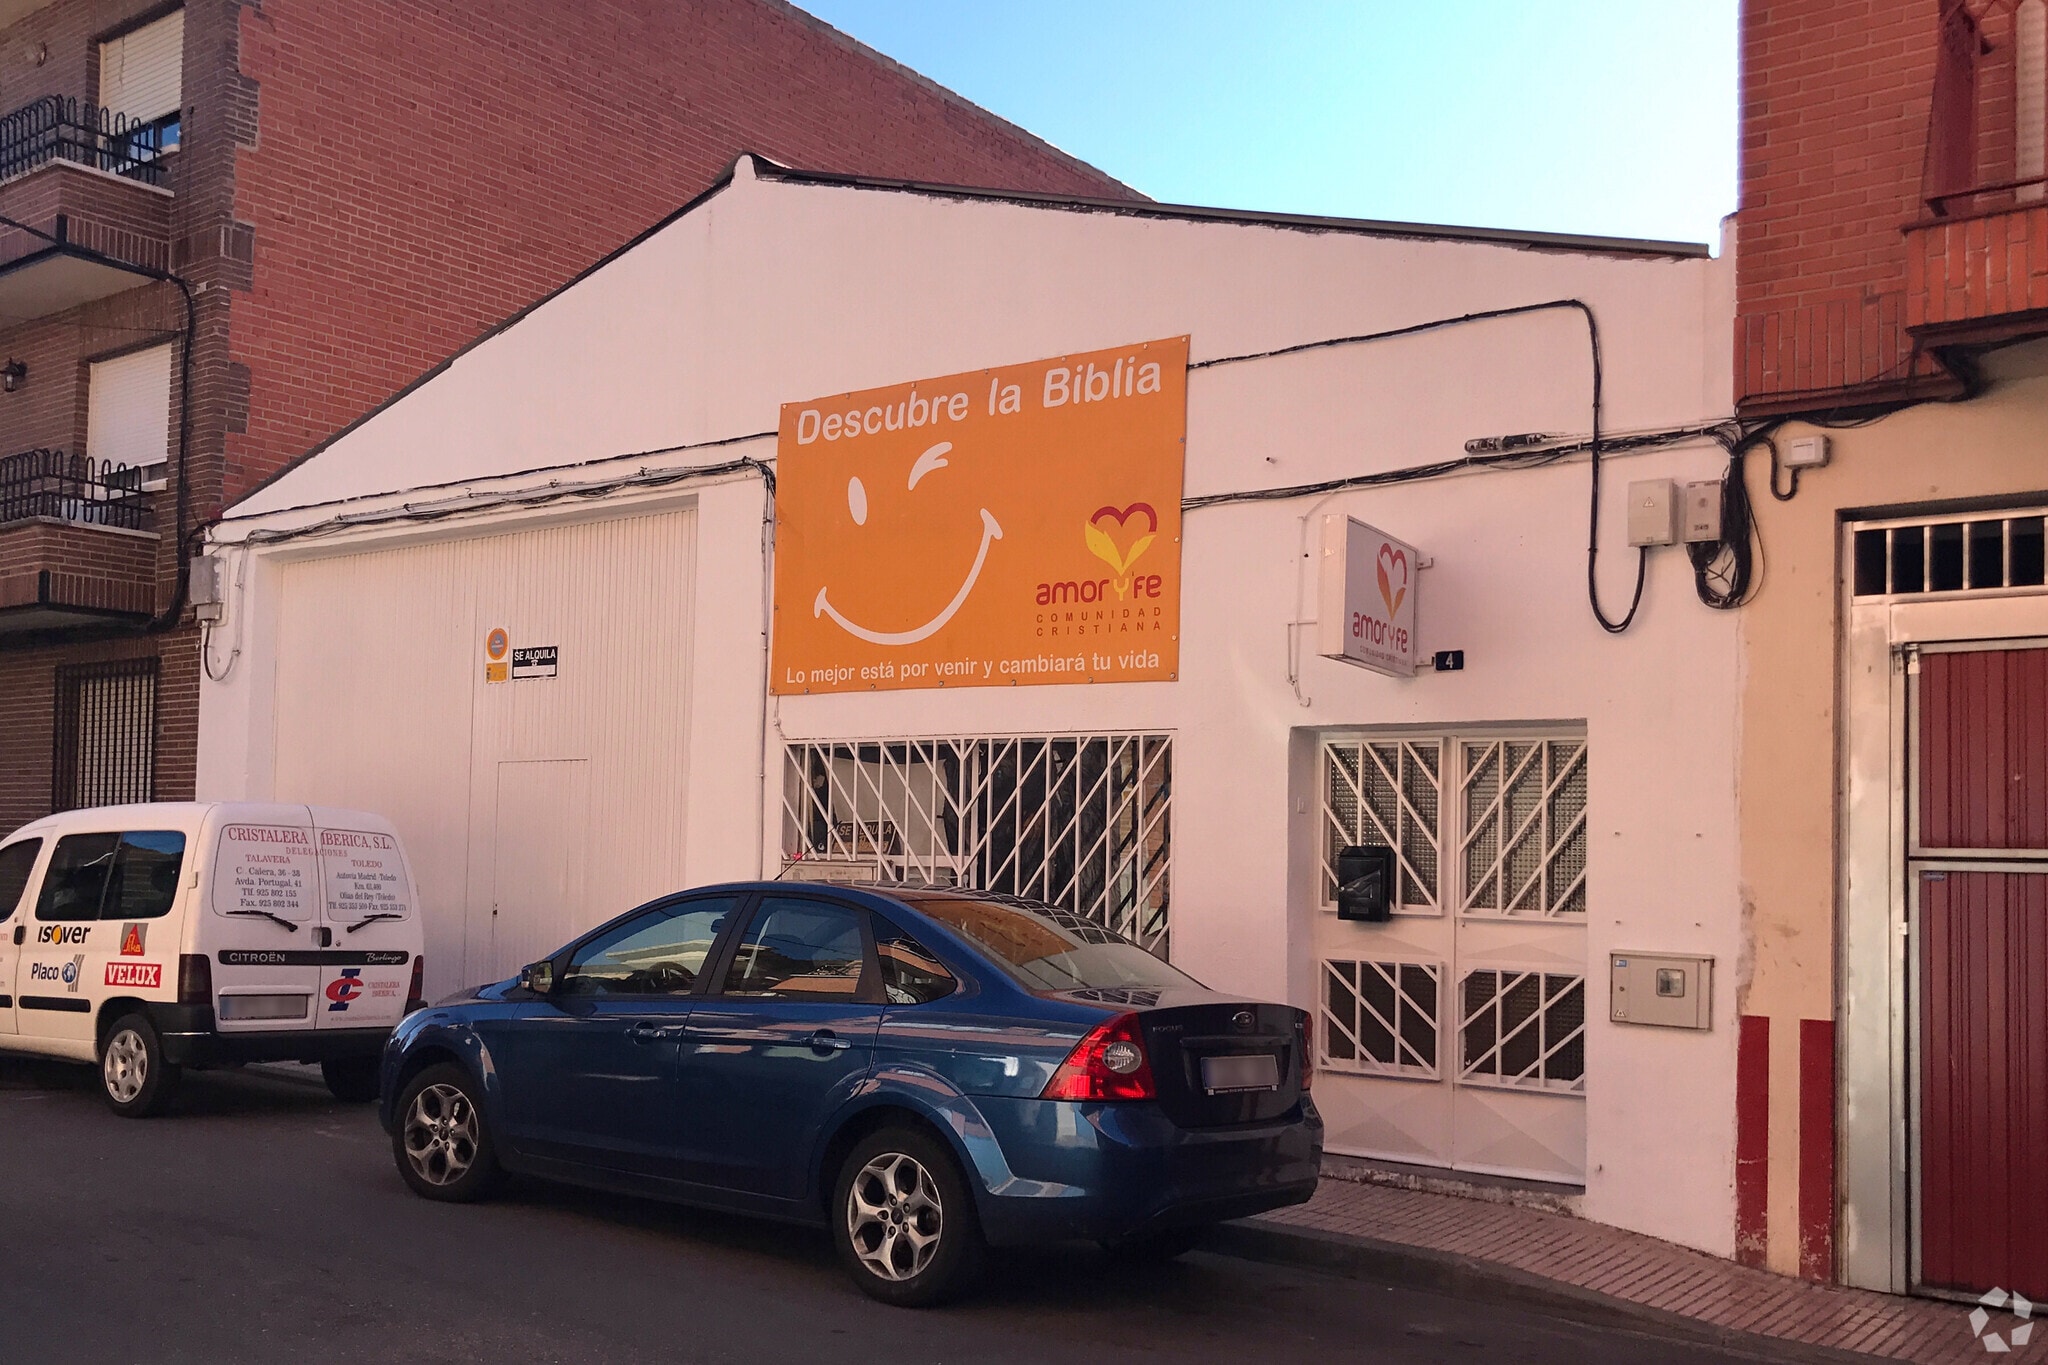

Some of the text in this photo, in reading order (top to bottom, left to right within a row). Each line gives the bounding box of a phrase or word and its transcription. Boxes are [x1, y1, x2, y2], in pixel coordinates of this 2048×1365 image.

[797, 356, 1161, 445] Descubre la Biblia
[1036, 606, 1161, 623] COMUNIDAD
[1036, 620, 1160, 637] CRISTIANA
[514, 649, 556, 661] SE ALQUILA
[1445, 652, 1453, 668] 4
[786, 649, 1159, 686] Lo mejor está por venir y cambiará tu vida
[839, 825, 852, 836] SE
[228, 827, 392, 851] CRISTALERA IBERICA, S.L.
[245, 854, 291, 864] TALAVERA
[285, 846, 348, 858] DELEGACIONES
[350, 859, 383, 869] TOLEDO
[248, 867, 276, 877] Calera,
[256, 889, 269, 897] 925
[229, 952, 402, 964] CITROËN Berlingo
[31, 962, 59, 980] Placo
[107, 964, 158, 985] VELUX
